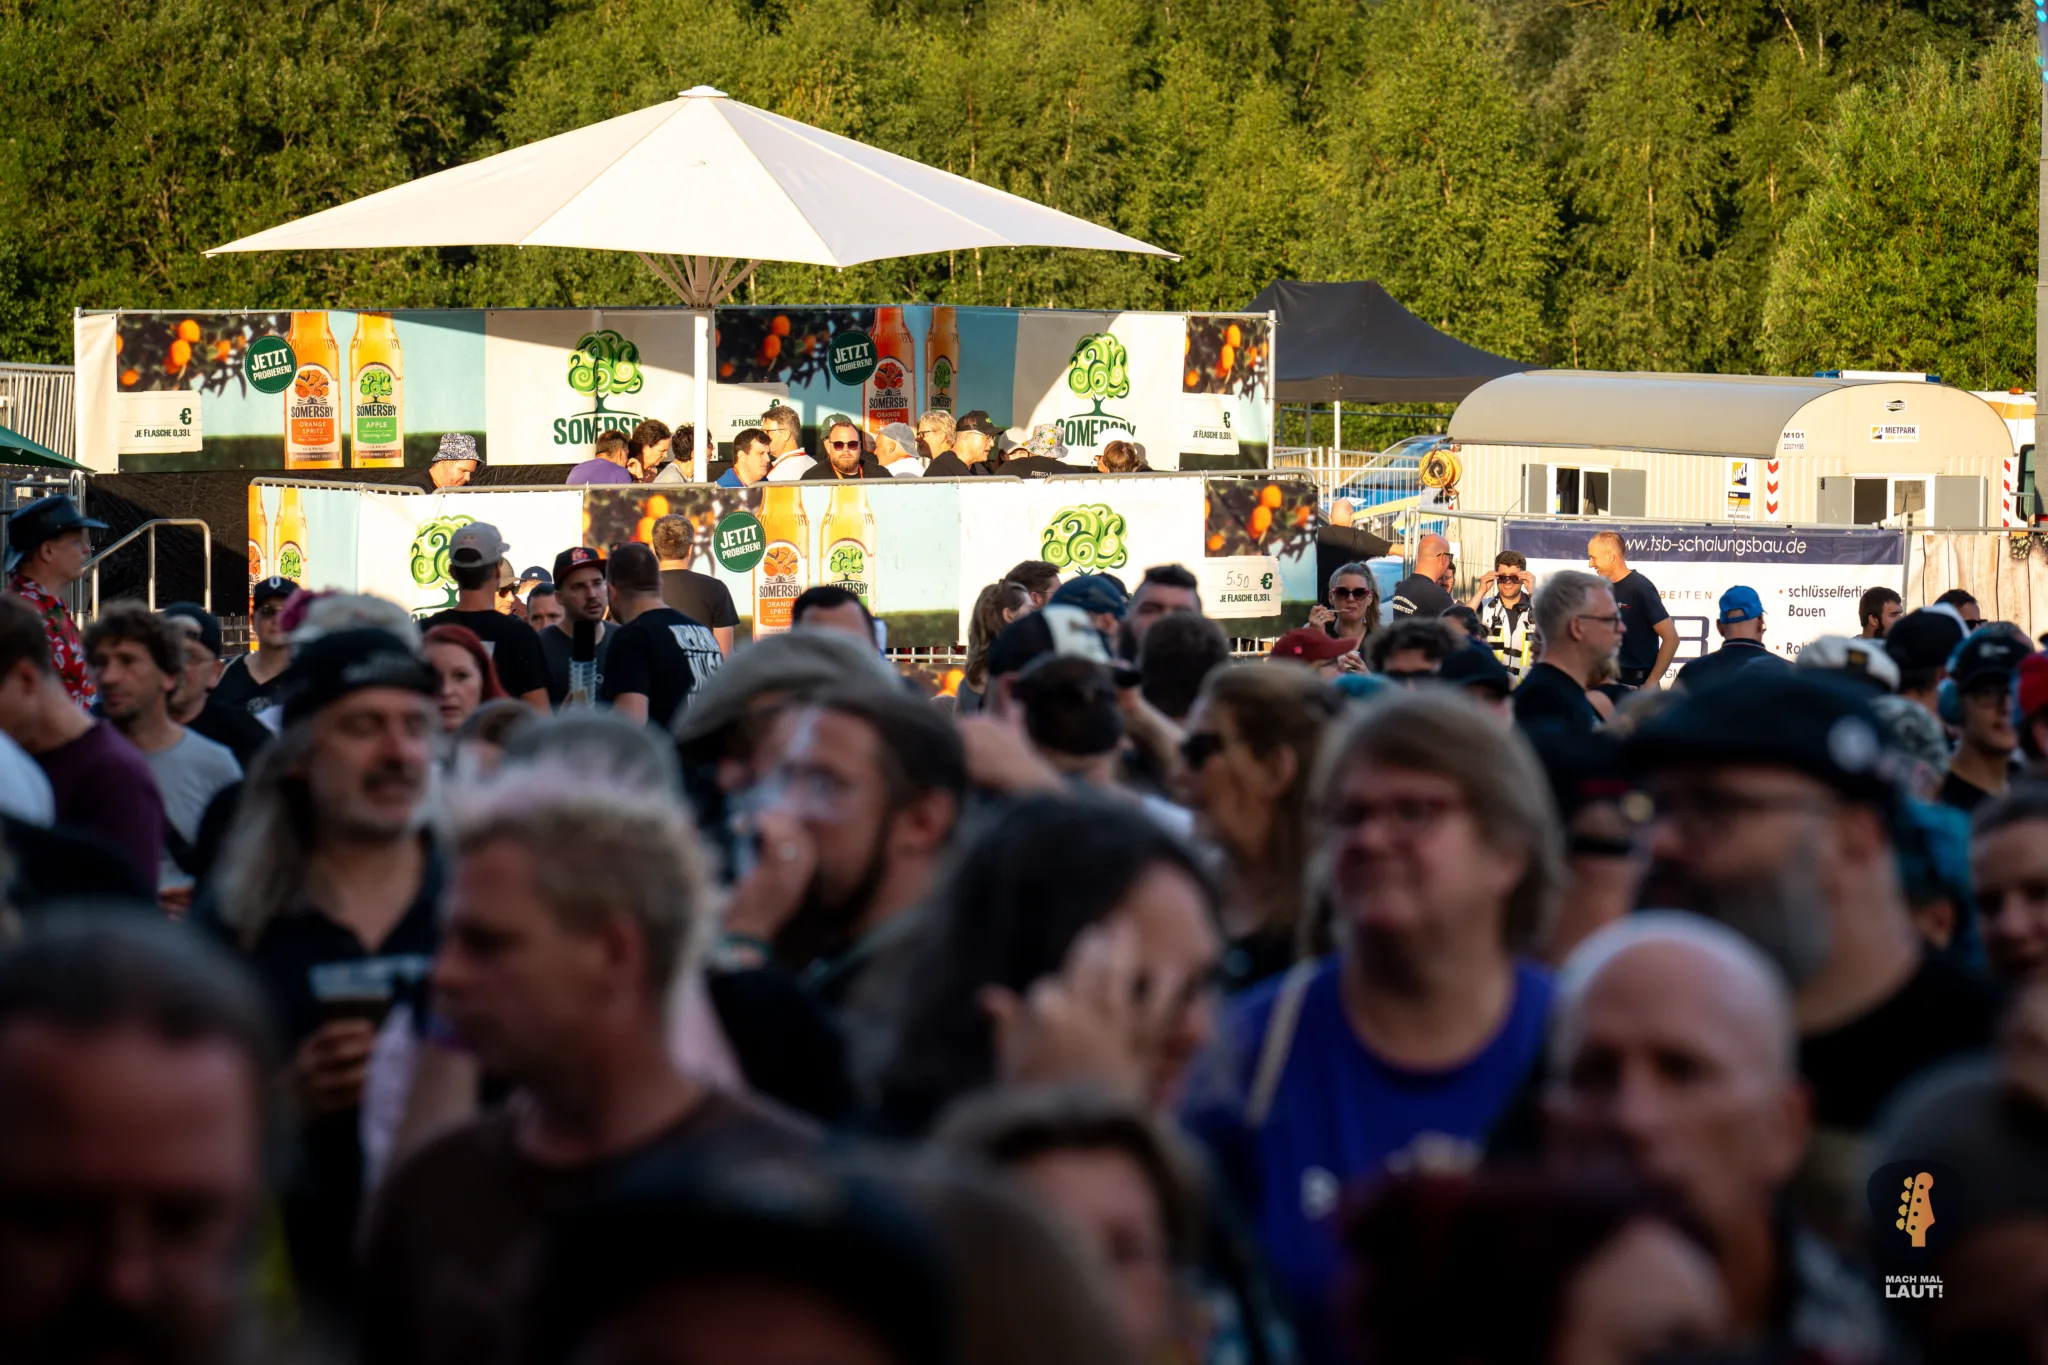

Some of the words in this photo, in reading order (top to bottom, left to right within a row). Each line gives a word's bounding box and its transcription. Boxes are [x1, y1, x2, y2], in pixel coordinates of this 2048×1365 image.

[251, 348, 288, 371] JETZT
[834, 342, 870, 364] JETZT
[835, 357, 873, 373] PROBIEREN!
[253, 364, 293, 382] PROBIEREN!
[869, 396, 909, 409] SOMERSBY
[291, 406, 334, 419] SOMERSBY
[356, 404, 397, 417] SOMERSBY
[731, 419, 738, 427] JE
[738, 418, 763, 427] FLASCHE
[134, 429, 143, 438] JE
[143, 429, 172, 438] FLASCHE
[1193, 430, 1198, 438] JE
[1199, 430, 1219, 439] FLASCHE
[1783, 431, 1805, 439] M101
[1885, 426, 1916, 434] MIETPARK
[720, 524, 757, 549] JETZT
[721, 541, 761, 560] PROBIEREN!
[1219, 595, 1227, 603] JE
[1227, 594, 1253, 603] FLASCHE
[1660, 590, 1712, 600] BEITEN
[1788, 604, 1826, 617] Bauen
